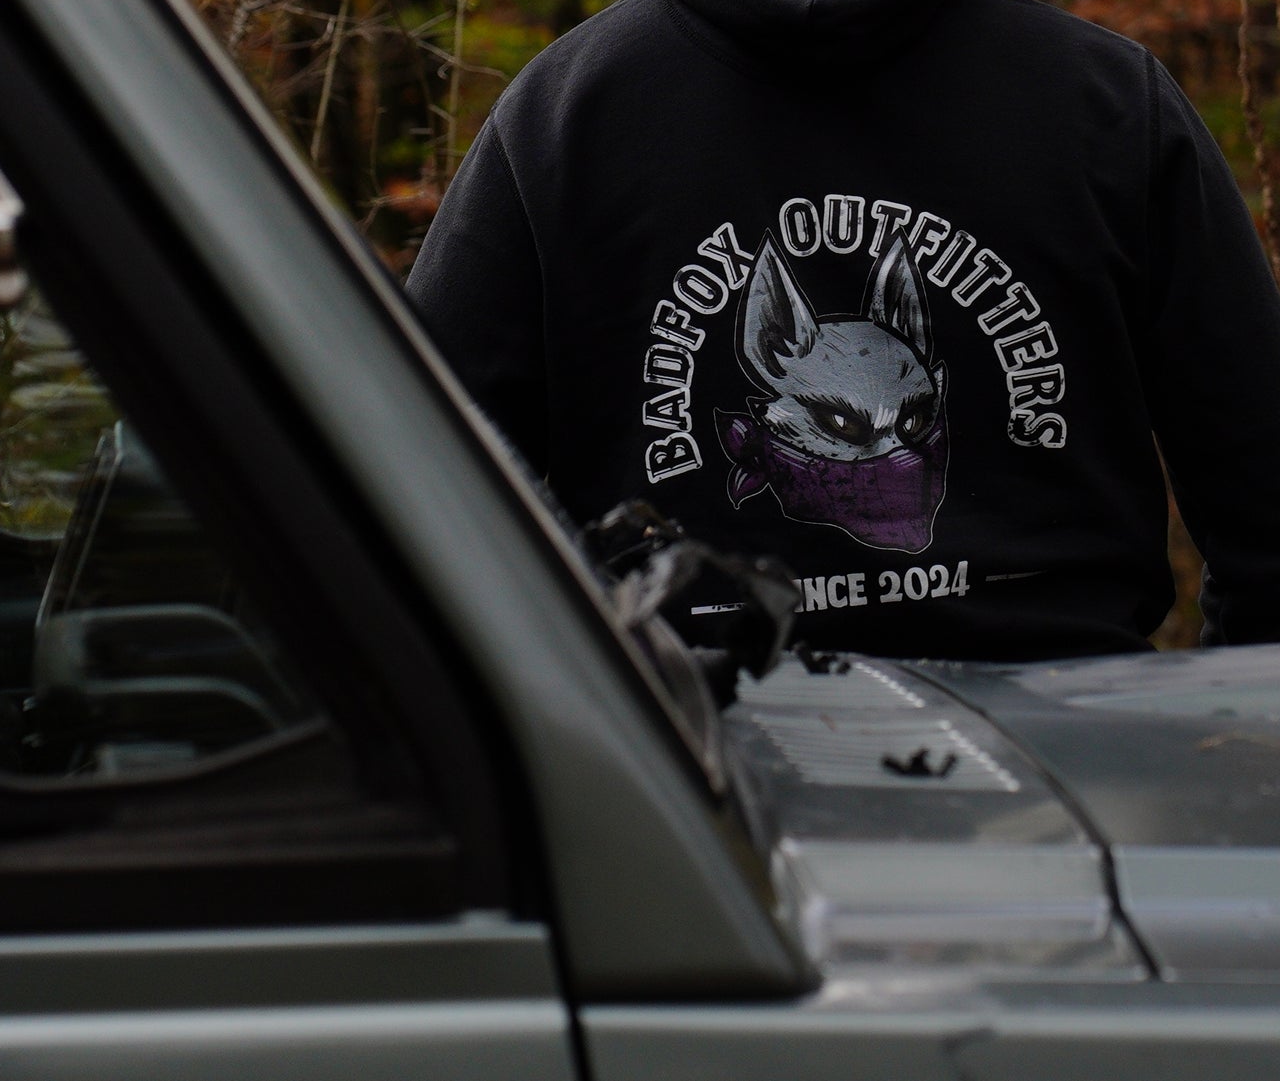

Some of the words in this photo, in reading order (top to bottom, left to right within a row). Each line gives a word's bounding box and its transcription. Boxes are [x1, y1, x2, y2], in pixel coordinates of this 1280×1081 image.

[642, 221, 756, 485] BADFOX
[778, 193, 1068, 449] OUTFITTERS
[791, 572, 868, 613] INCE
[878, 560, 970, 604] 2024
